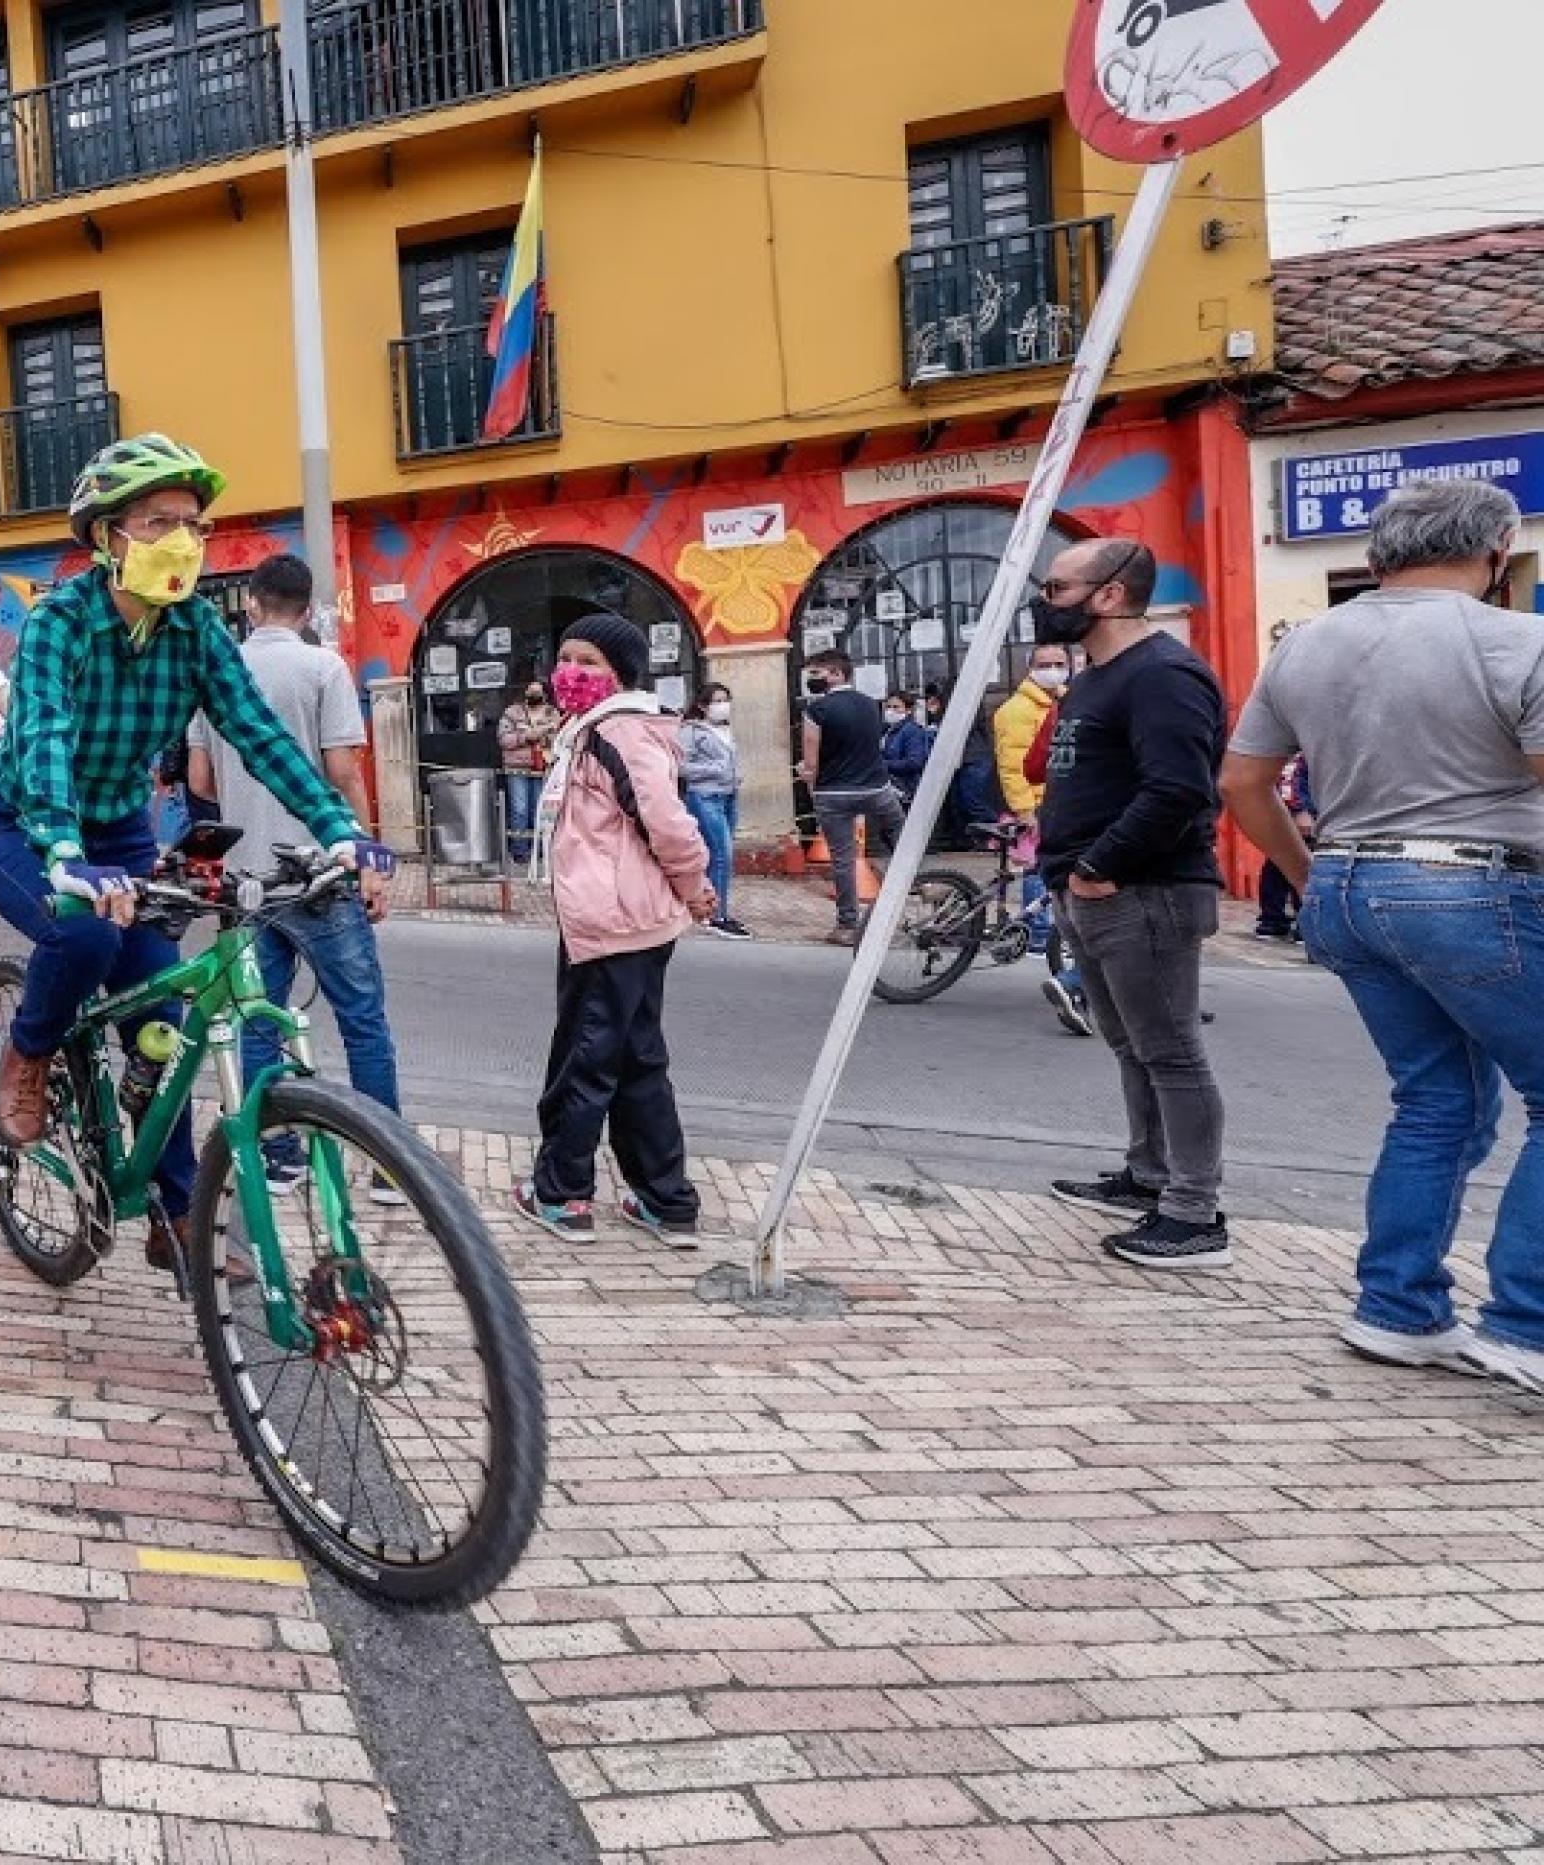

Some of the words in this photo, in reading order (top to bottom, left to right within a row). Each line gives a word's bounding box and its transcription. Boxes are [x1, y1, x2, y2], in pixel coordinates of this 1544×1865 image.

[994, 446, 1027, 467] 59
[1296, 451, 1404, 479] CAFETERÍA
[1296, 474, 1364, 497] PUNTO
[1367, 471, 1393, 490] DE
[1297, 498, 1324, 531] B
[1340, 498, 1370, 528] &
